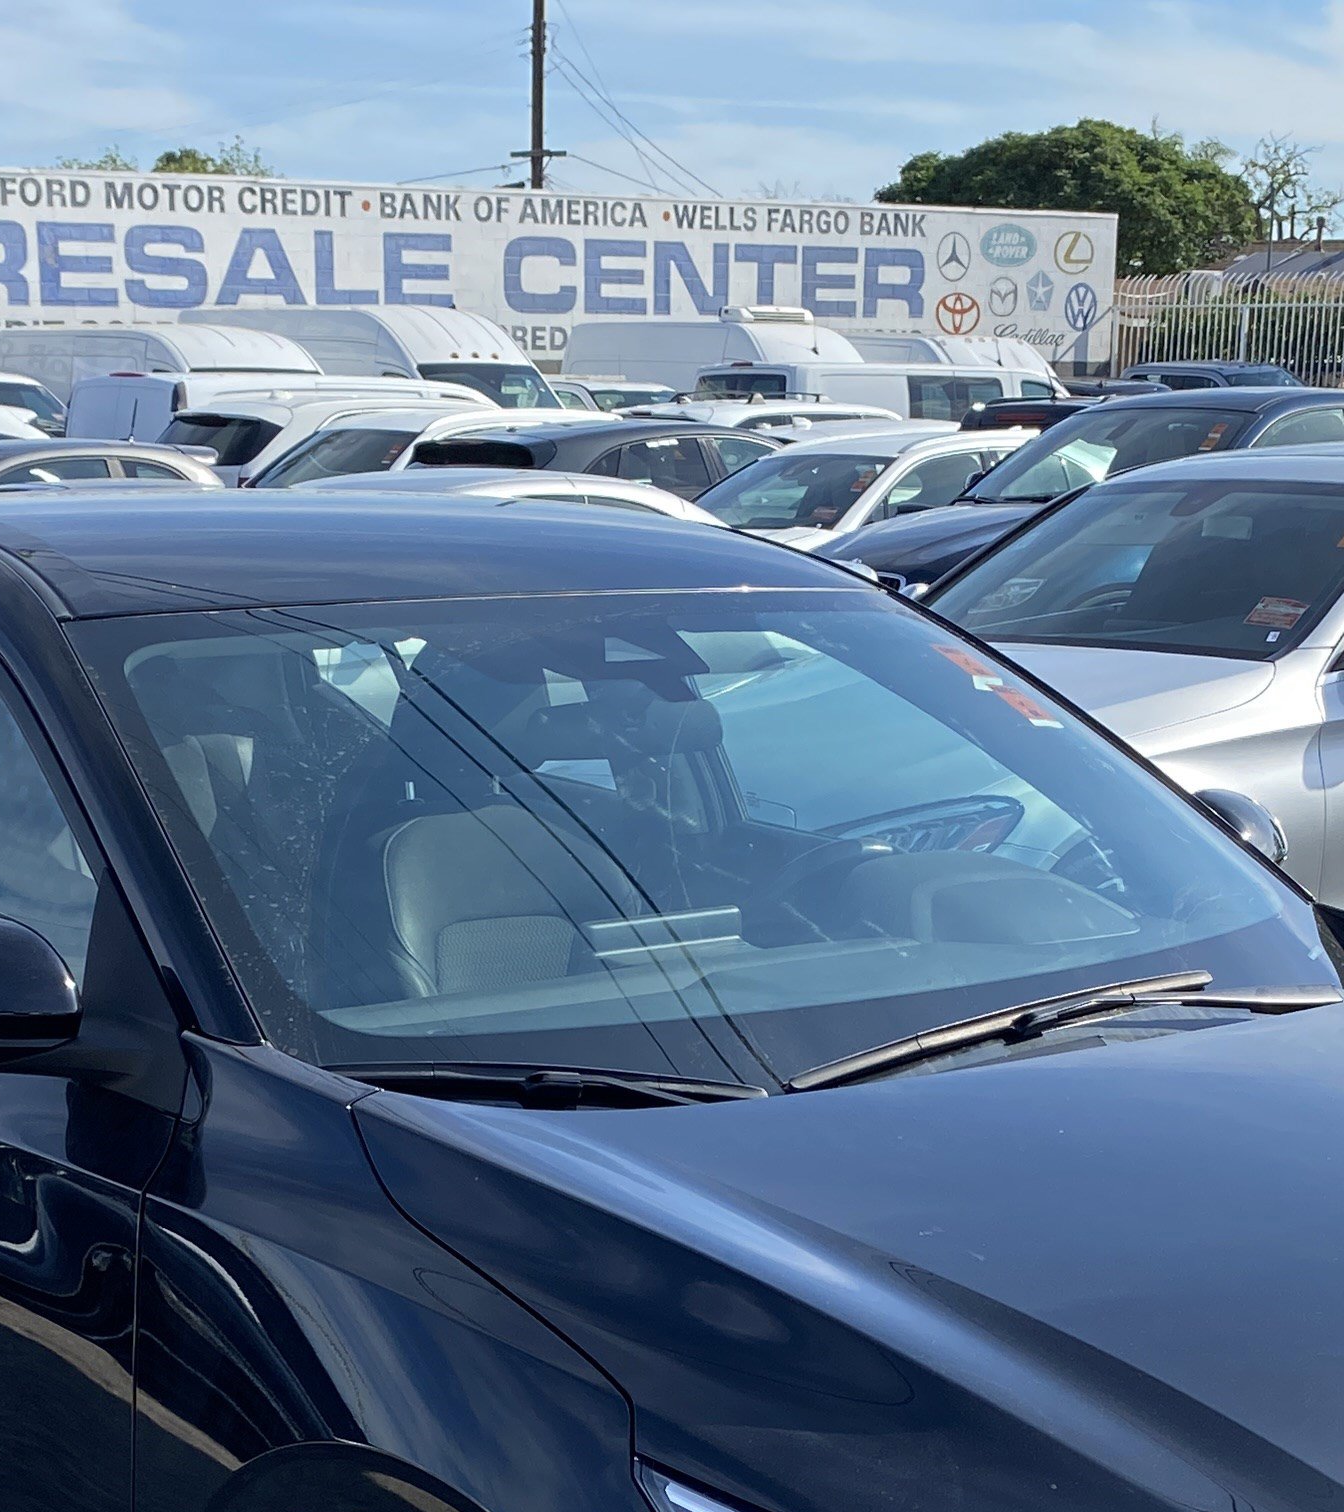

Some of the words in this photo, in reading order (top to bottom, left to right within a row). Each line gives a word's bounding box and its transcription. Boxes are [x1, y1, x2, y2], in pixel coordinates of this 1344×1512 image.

[0, 177, 91, 208] FORD
[104, 180, 226, 214] MOTOR
[238, 186, 353, 218] CREDIT
[379, 191, 462, 222] BANK
[473, 195, 510, 223] OF
[518, 198, 648, 228] AMERICA
[672, 204, 757, 232] WELLS
[767, 208, 850, 235] FARGO
[859, 211, 927, 238] BANK
[503, 235, 925, 319] CENTER
